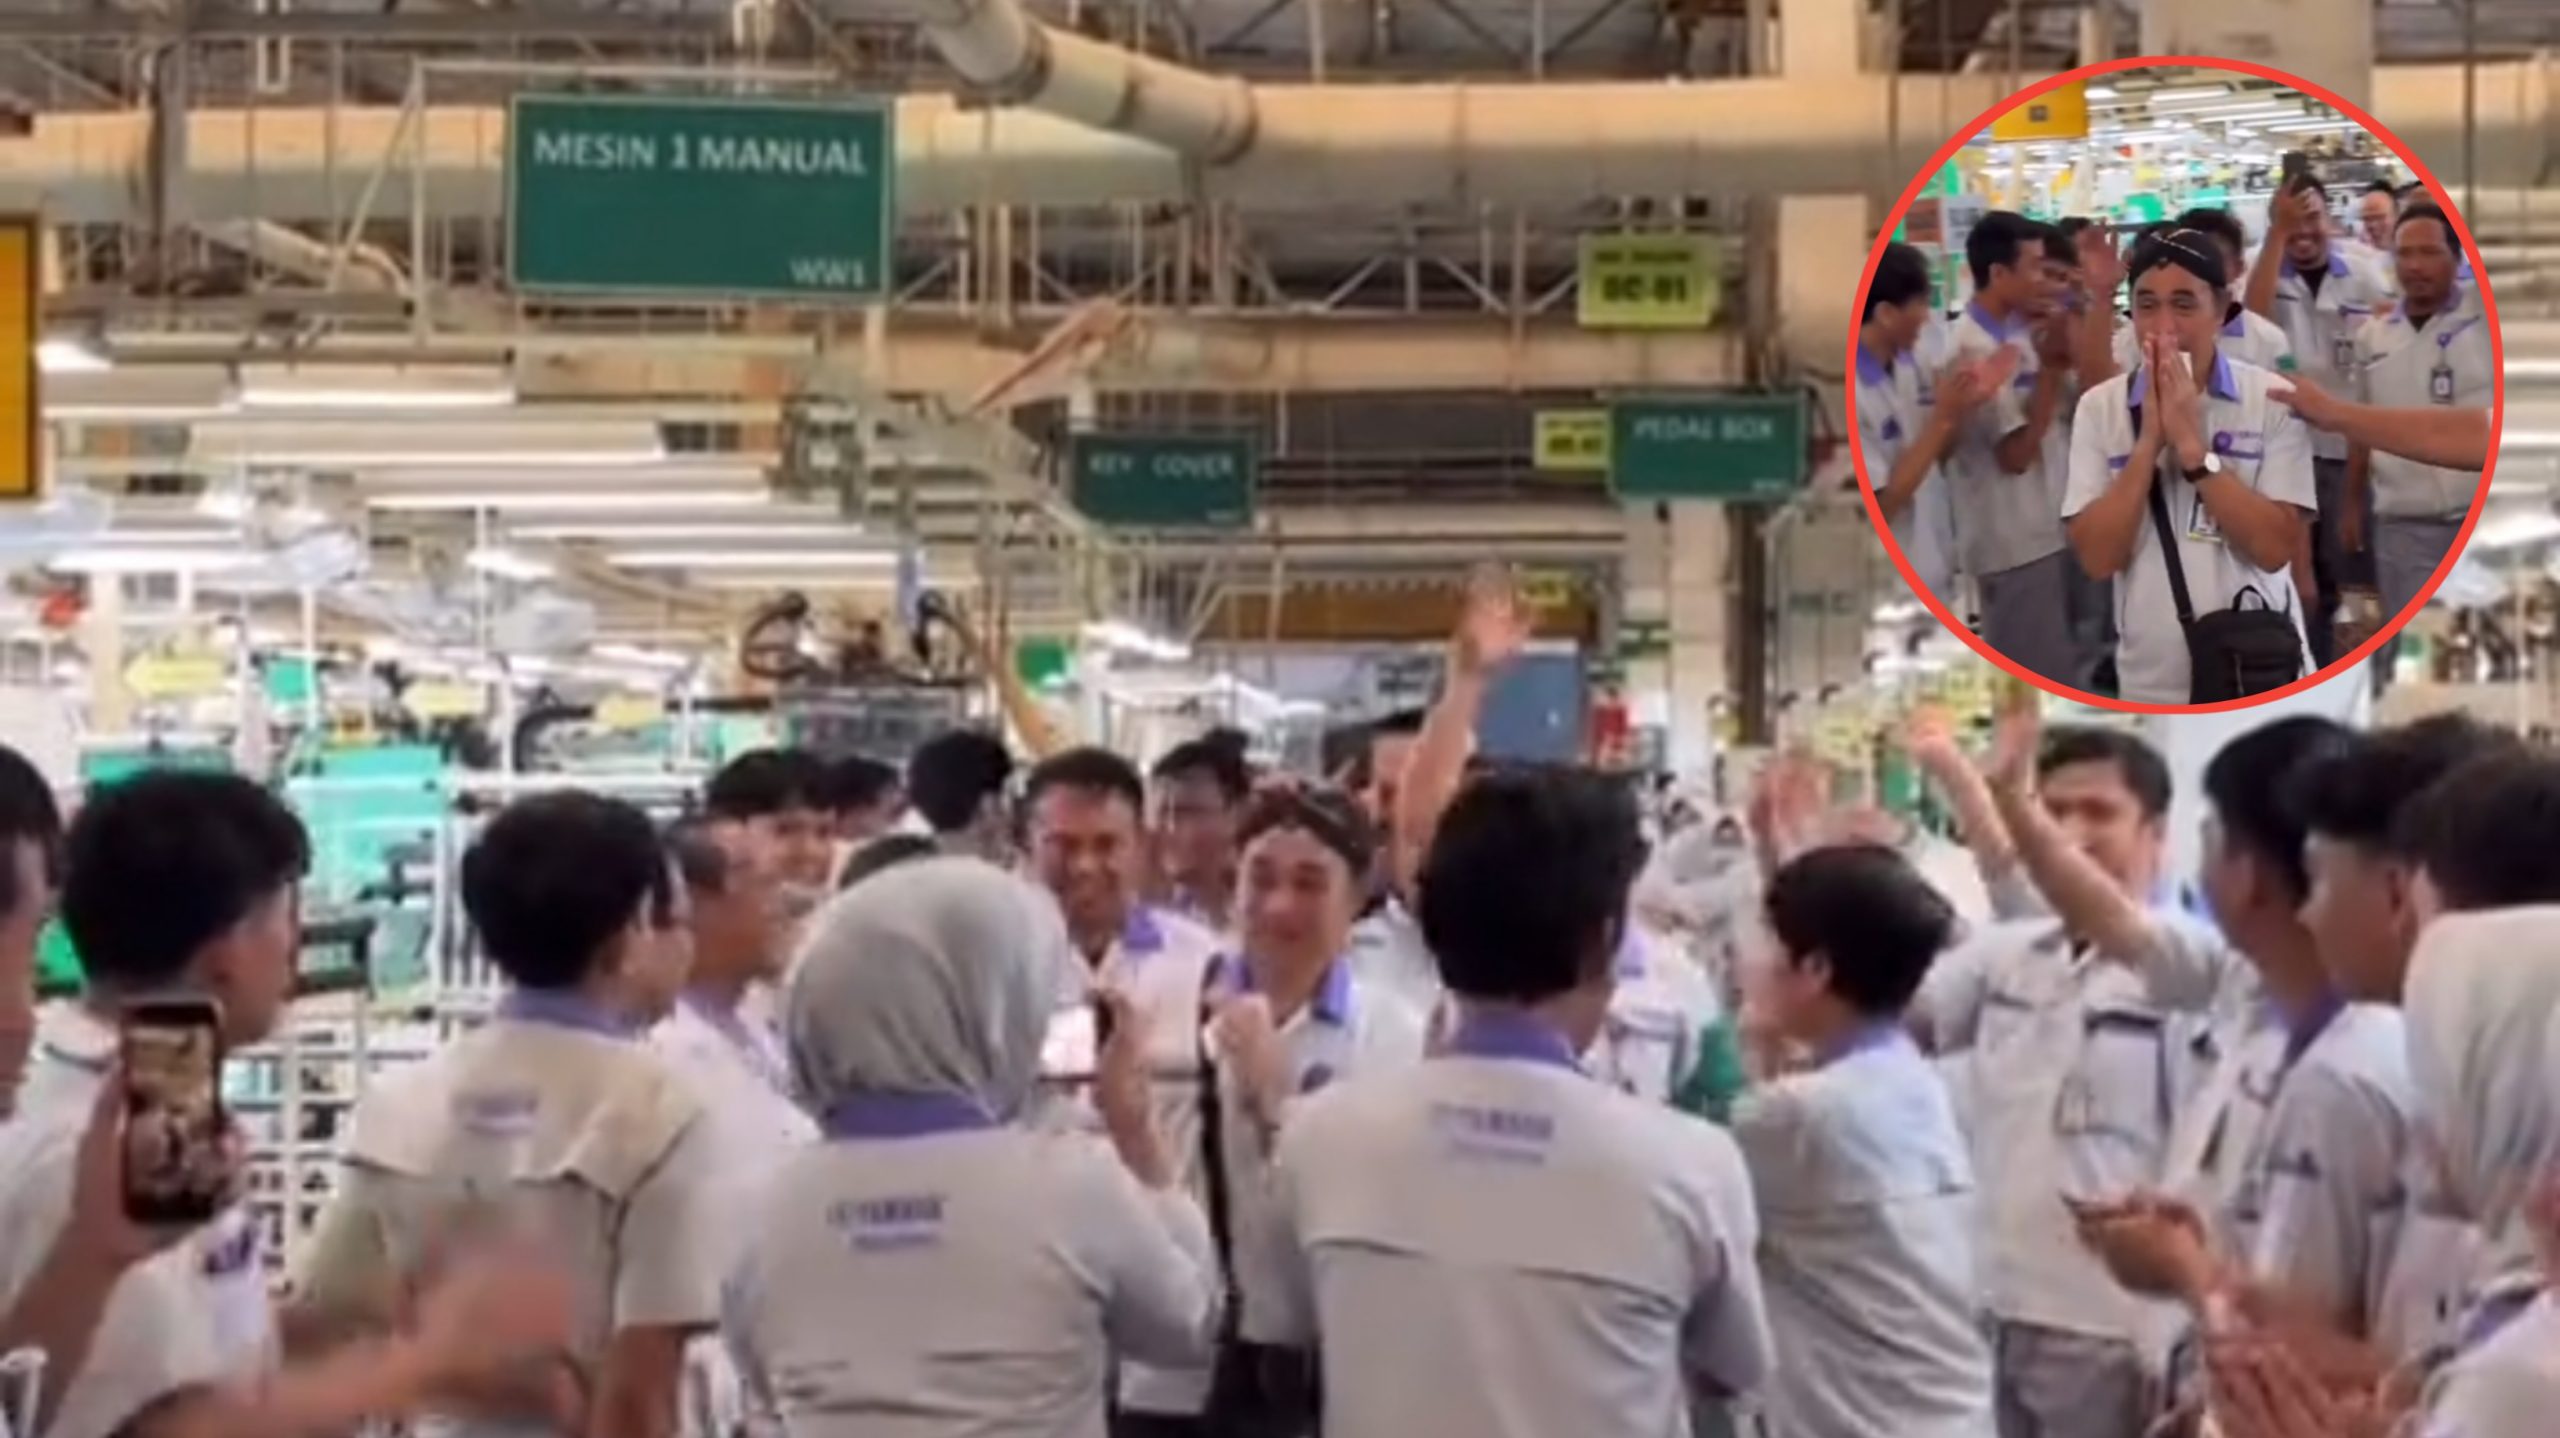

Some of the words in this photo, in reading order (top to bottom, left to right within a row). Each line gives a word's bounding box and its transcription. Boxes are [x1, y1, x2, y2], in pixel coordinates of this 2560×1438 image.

[533, 131, 656, 169] MESIN
[671, 133, 689, 169] 1
[699, 137, 868, 175] MANUAL
[791, 259, 865, 287] WW1
[1721, 417, 1774, 440] BOX
[1089, 454, 1133, 475] KEY
[1152, 454, 1233, 478] COVER
